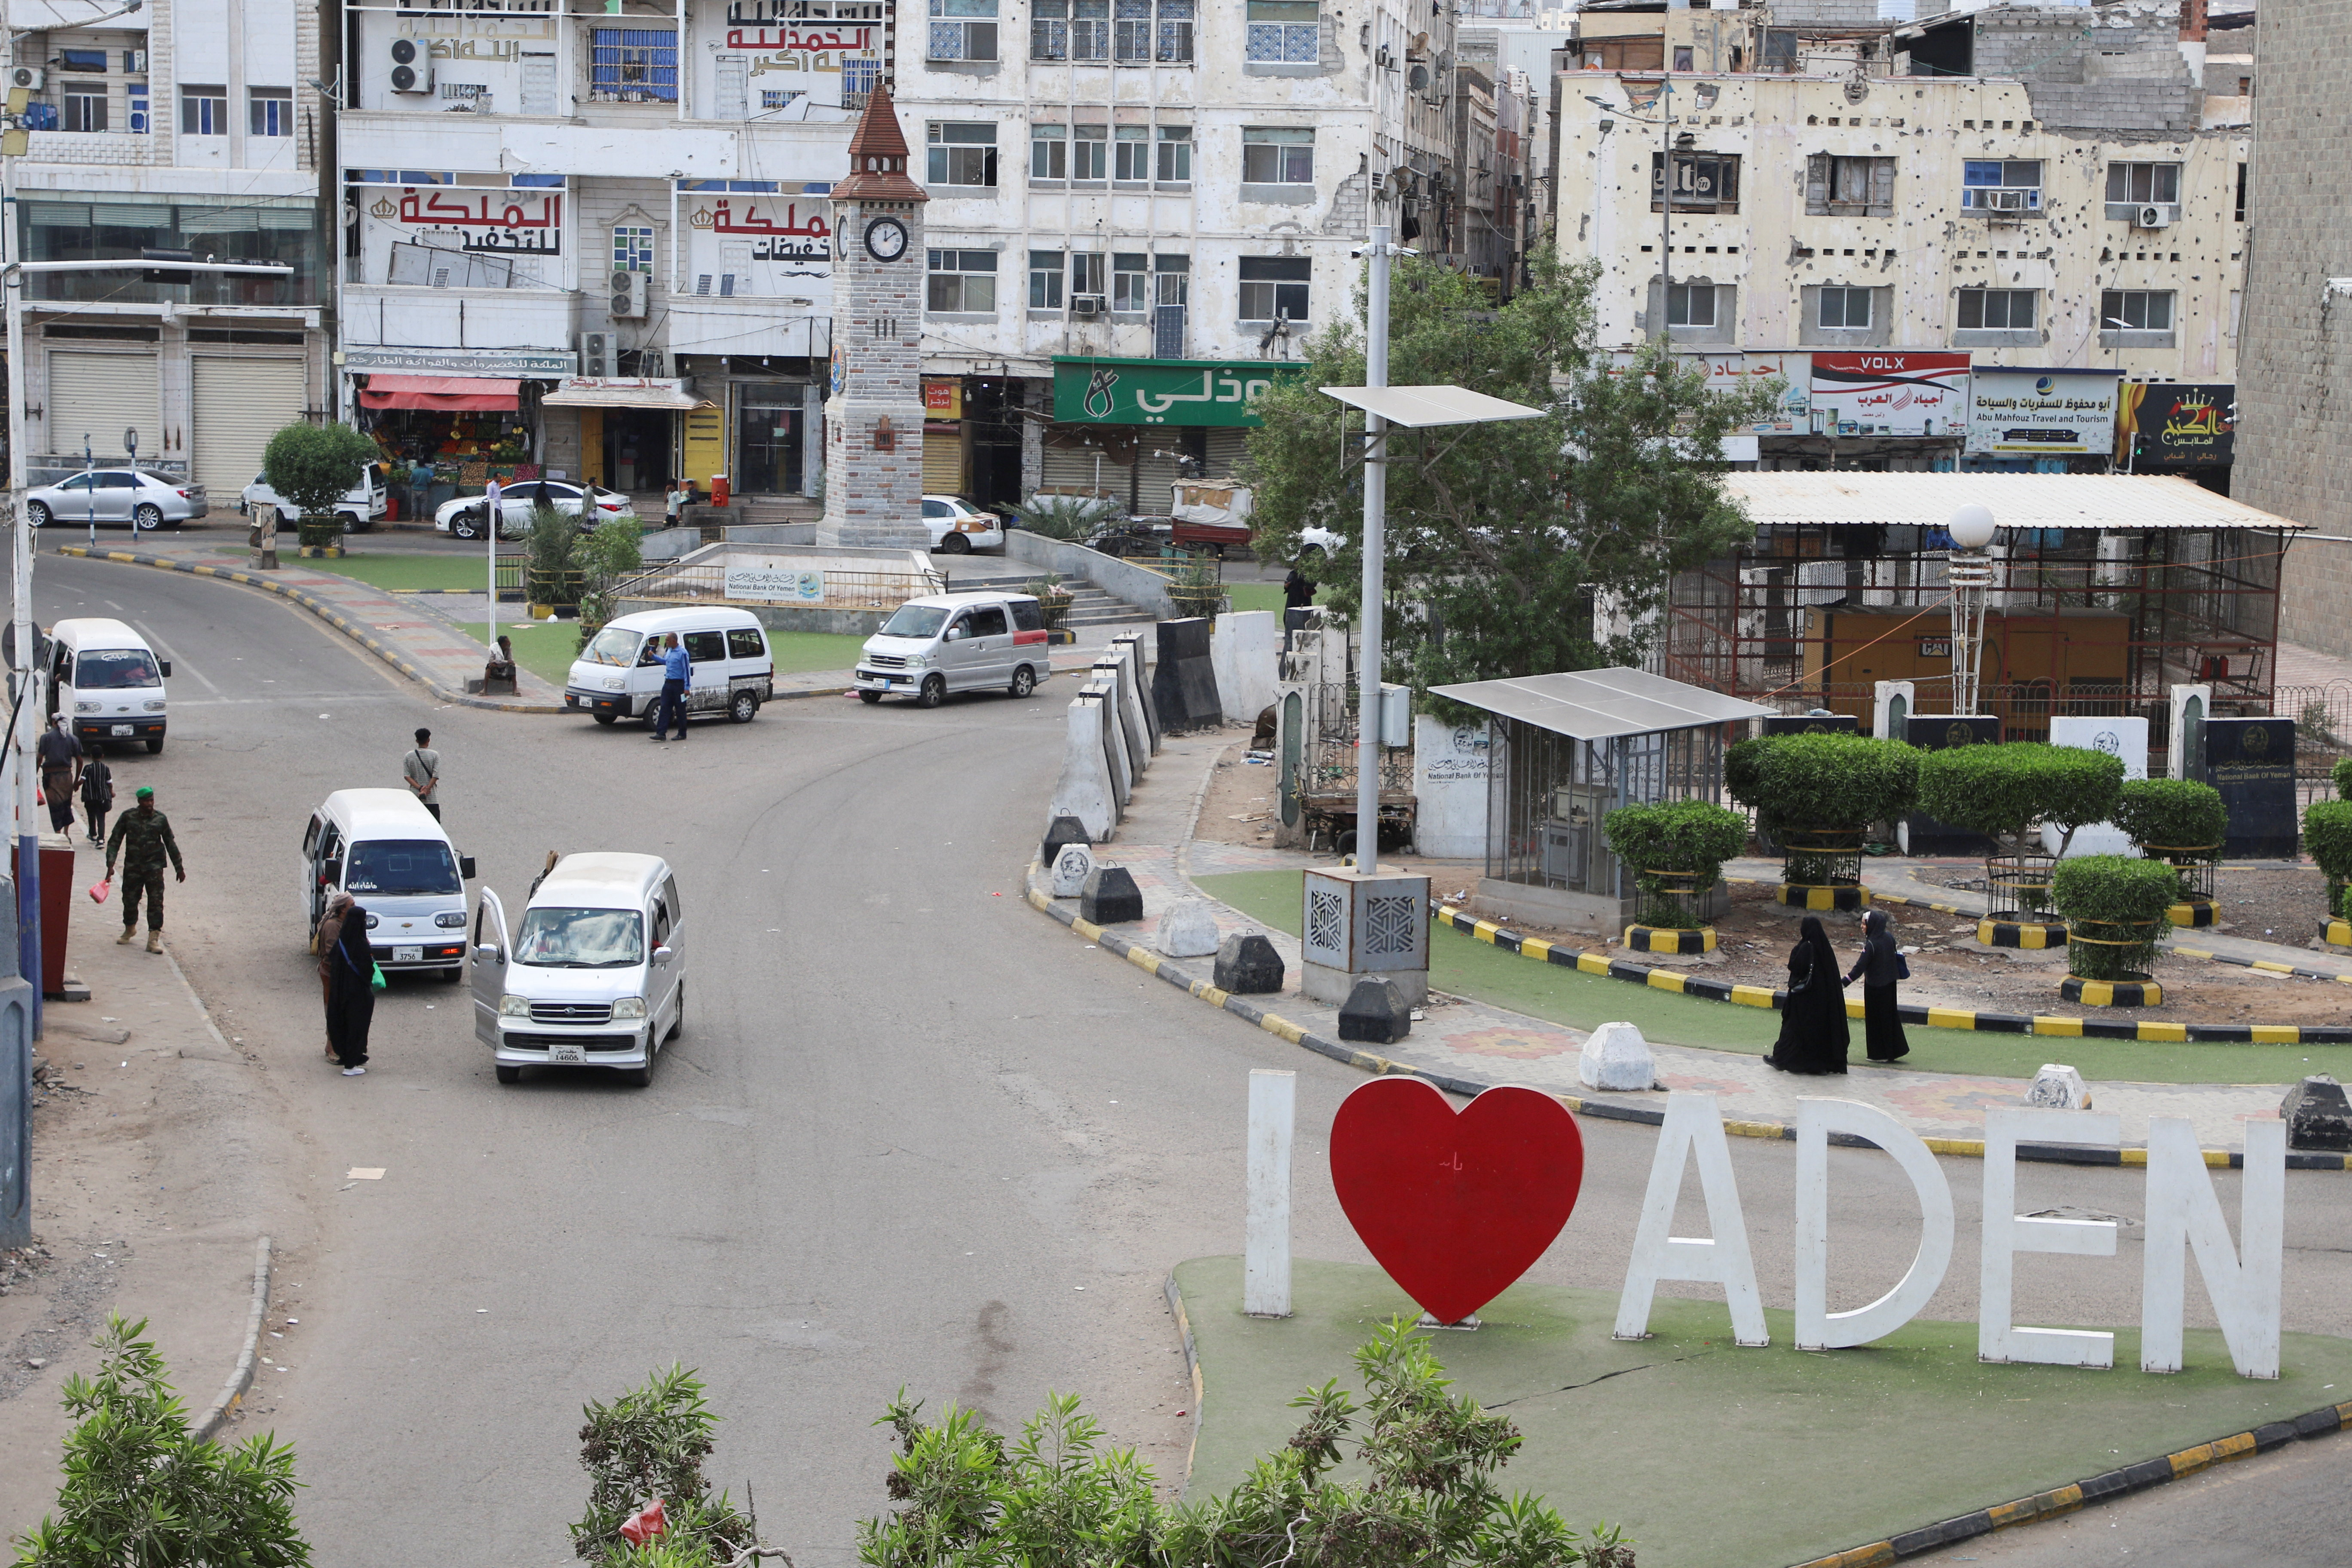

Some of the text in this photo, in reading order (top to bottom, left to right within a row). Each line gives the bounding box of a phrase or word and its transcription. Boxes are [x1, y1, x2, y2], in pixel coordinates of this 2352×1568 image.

[400, 187, 560, 229] الملكة
[714, 199, 831, 238] ملكة
[753, 236, 831, 266] خفيضات
[532, 361, 568, 370] الملكة
[1861, 357, 1905, 369] VOLX
[928, 387, 949, 397] هوت
[1858, 389, 1944, 407] أجياد العرب
[1976, 396, 2111, 413] أبو محفوظ للسفريات والسياحة
[1977, 413, 2108, 423] Abu Mahfouz Travel and Tourism
[2174, 436, 2214, 447] للملابس
[2163, 451, 2217, 463] رجالي شبابي
[1922, 638, 1951, 656] CAT
[348, 881, 359, 889] الله
[1245, 1069, 2287, 1381] I ADEN
